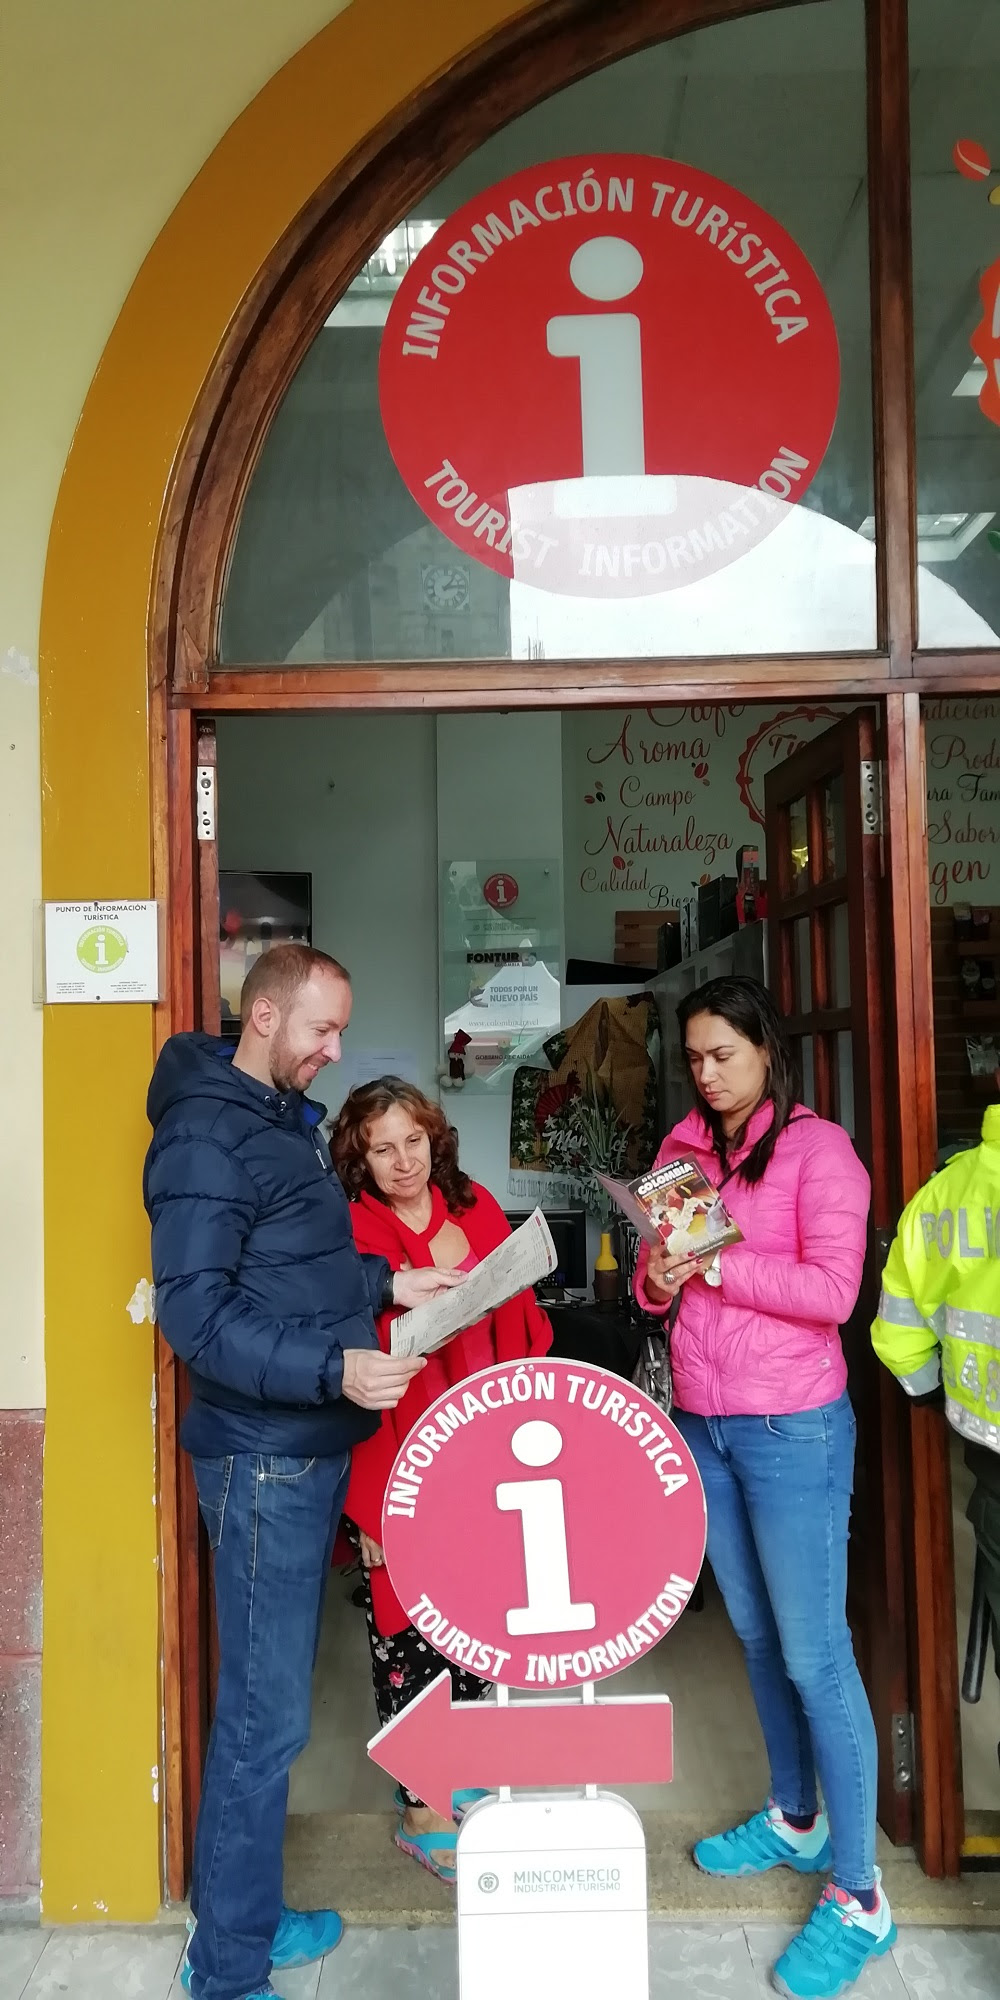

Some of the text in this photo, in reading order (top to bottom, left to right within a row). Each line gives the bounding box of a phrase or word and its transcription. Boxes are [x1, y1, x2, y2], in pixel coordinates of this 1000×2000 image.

[402, 168, 634, 360] INFORMACIÓN
[423, 446, 811, 578] TOURIST INFORMATION
[586, 714, 711, 765] Aroma
[619, 775, 696, 816] Campo
[584, 814, 734, 866] Naturaleza
[928, 809, 1000, 844] Sabor
[580, 866, 651, 893] Calidad
[83, 913, 119, 921] TURÍSTICA
[93, 904, 147, 912] INFORMACIÓN
[466, 952, 520, 963] FONTUR
[490, 993, 538, 1002] NUEVO PAÍS
[637, 1162, 694, 1195] COLOMBIA
[920, 1207, 1000, 1262] POLI
[387, 1365, 555, 1519] INFORMACIÓN
[407, 1573, 695, 1683] TOURIST INFORMATION
[513, 1868, 621, 1884] MINCOMERCIO
[513, 1882, 621, 1893] INDUSTRIA Y TURISMO
